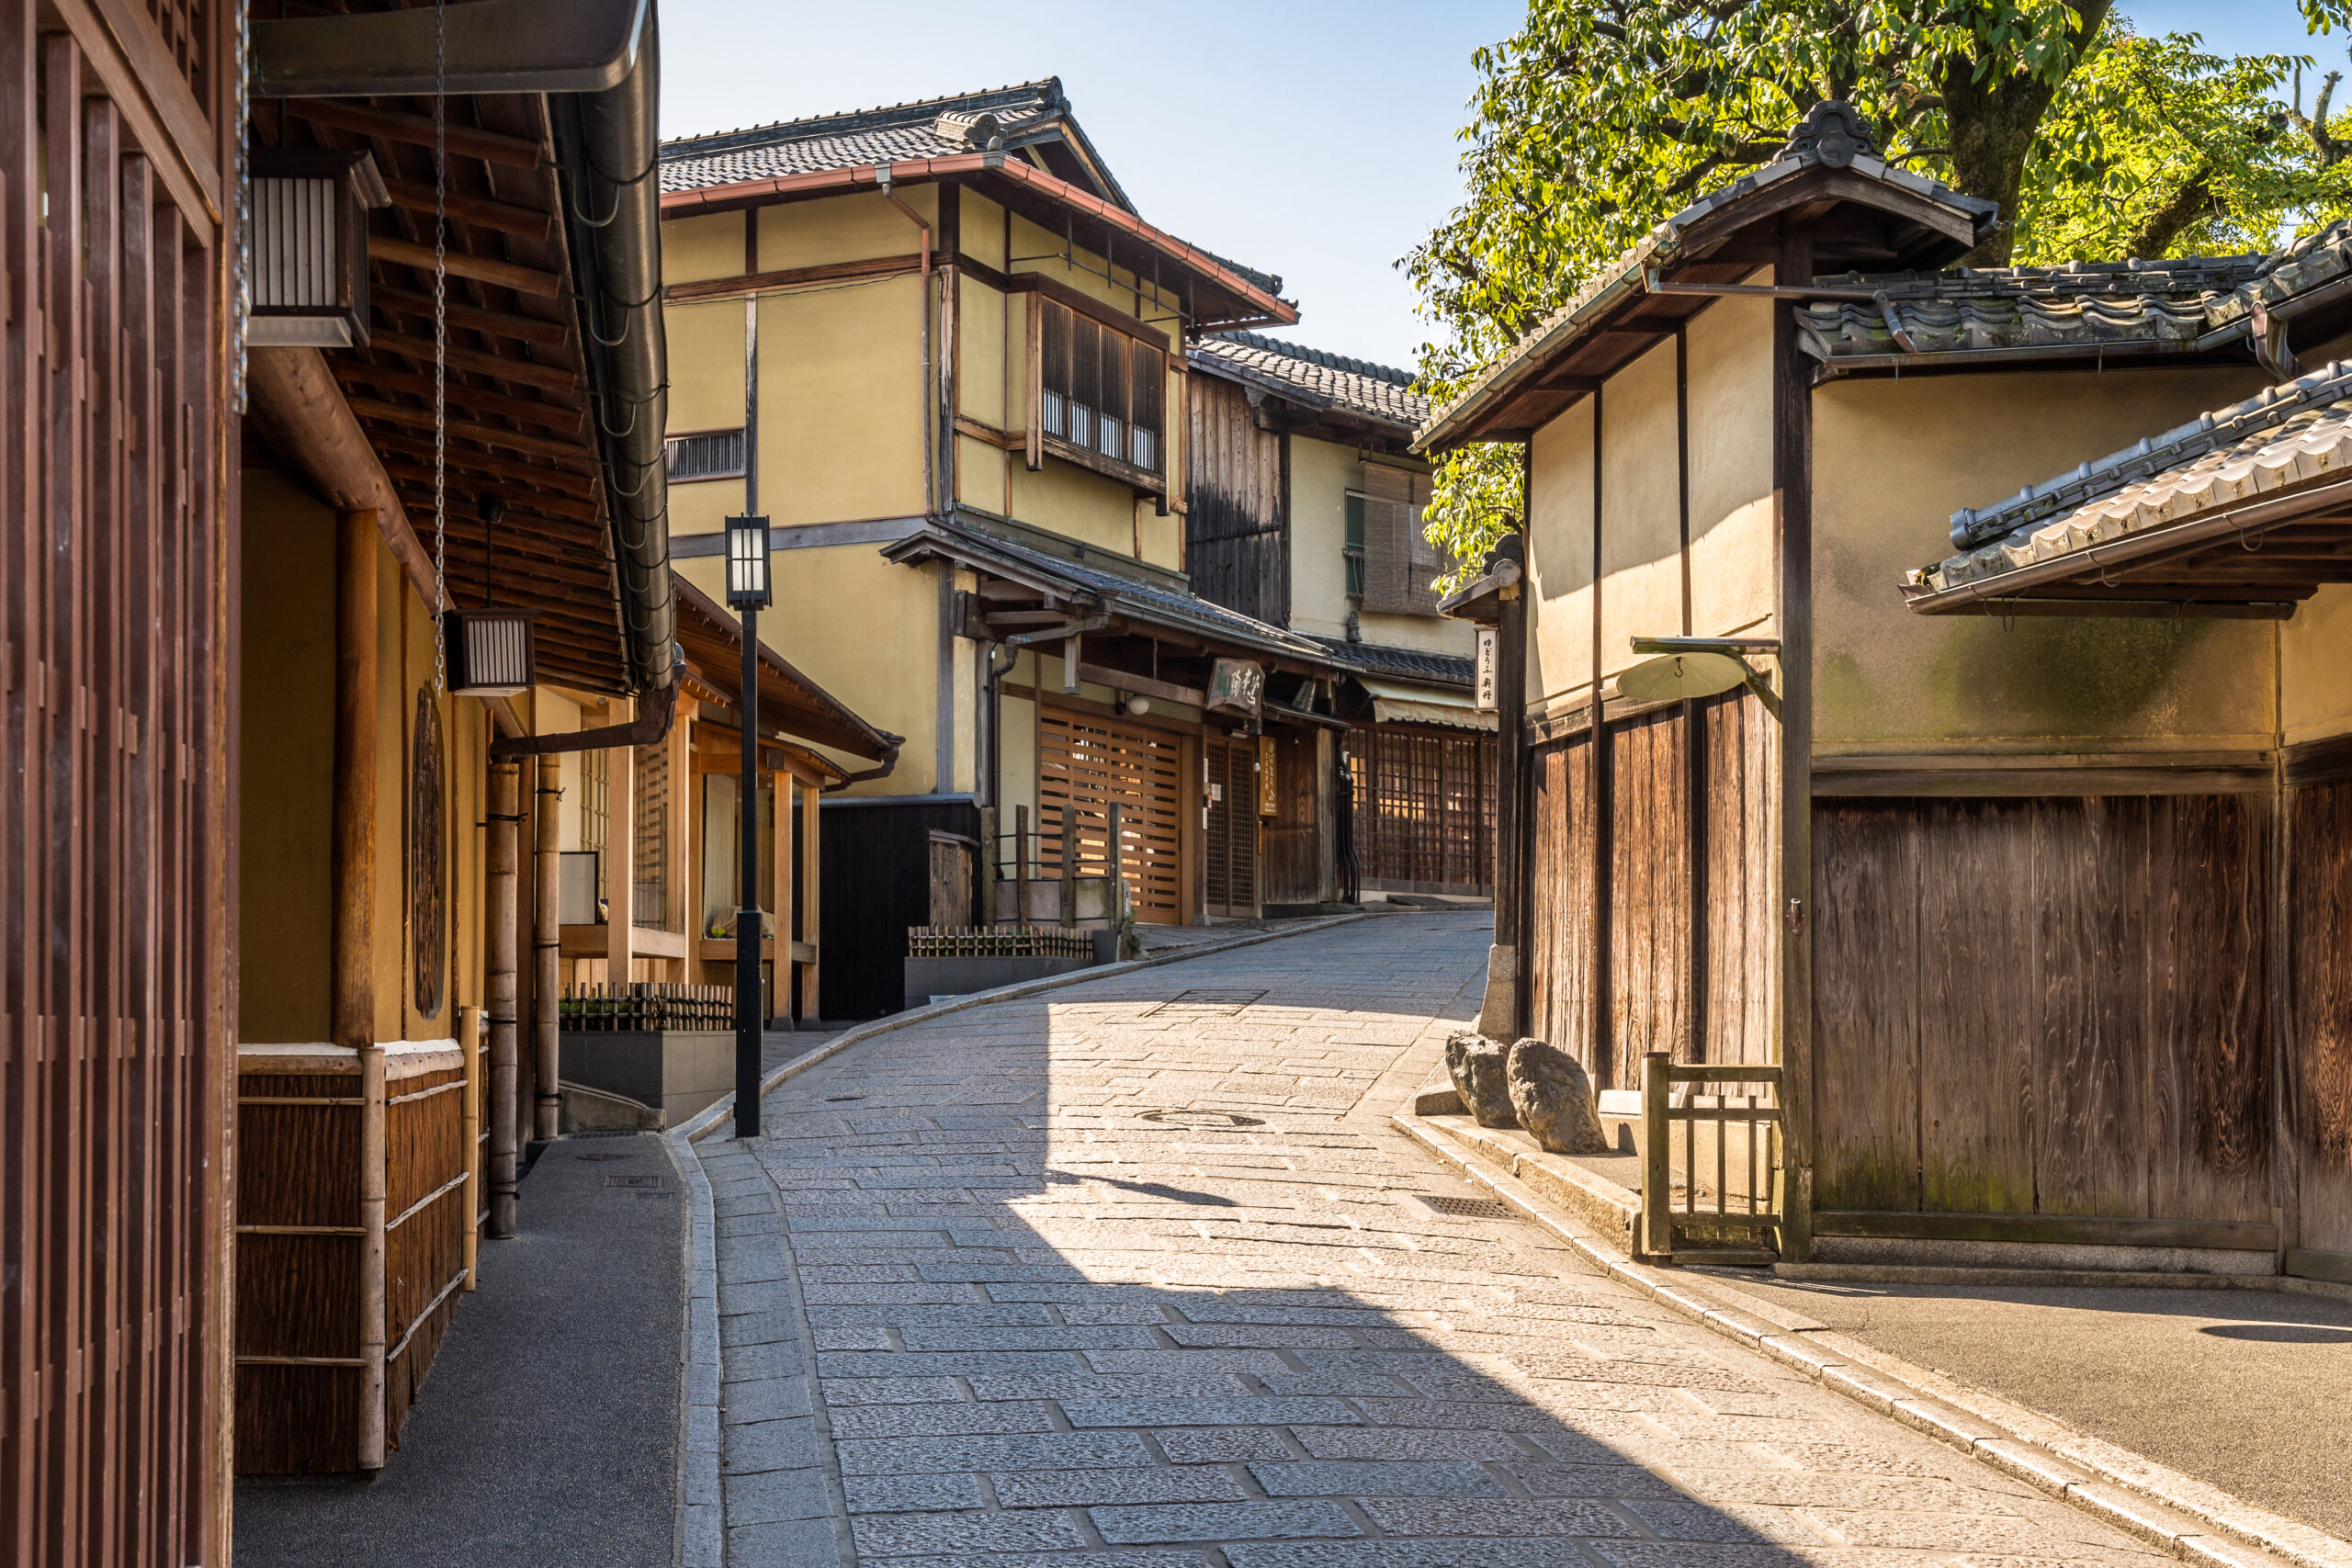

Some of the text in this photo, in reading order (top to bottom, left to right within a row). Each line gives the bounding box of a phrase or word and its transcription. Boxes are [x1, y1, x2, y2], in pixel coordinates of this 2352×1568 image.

[1481, 638, 1492, 700] ゆどうふ 奥丹
